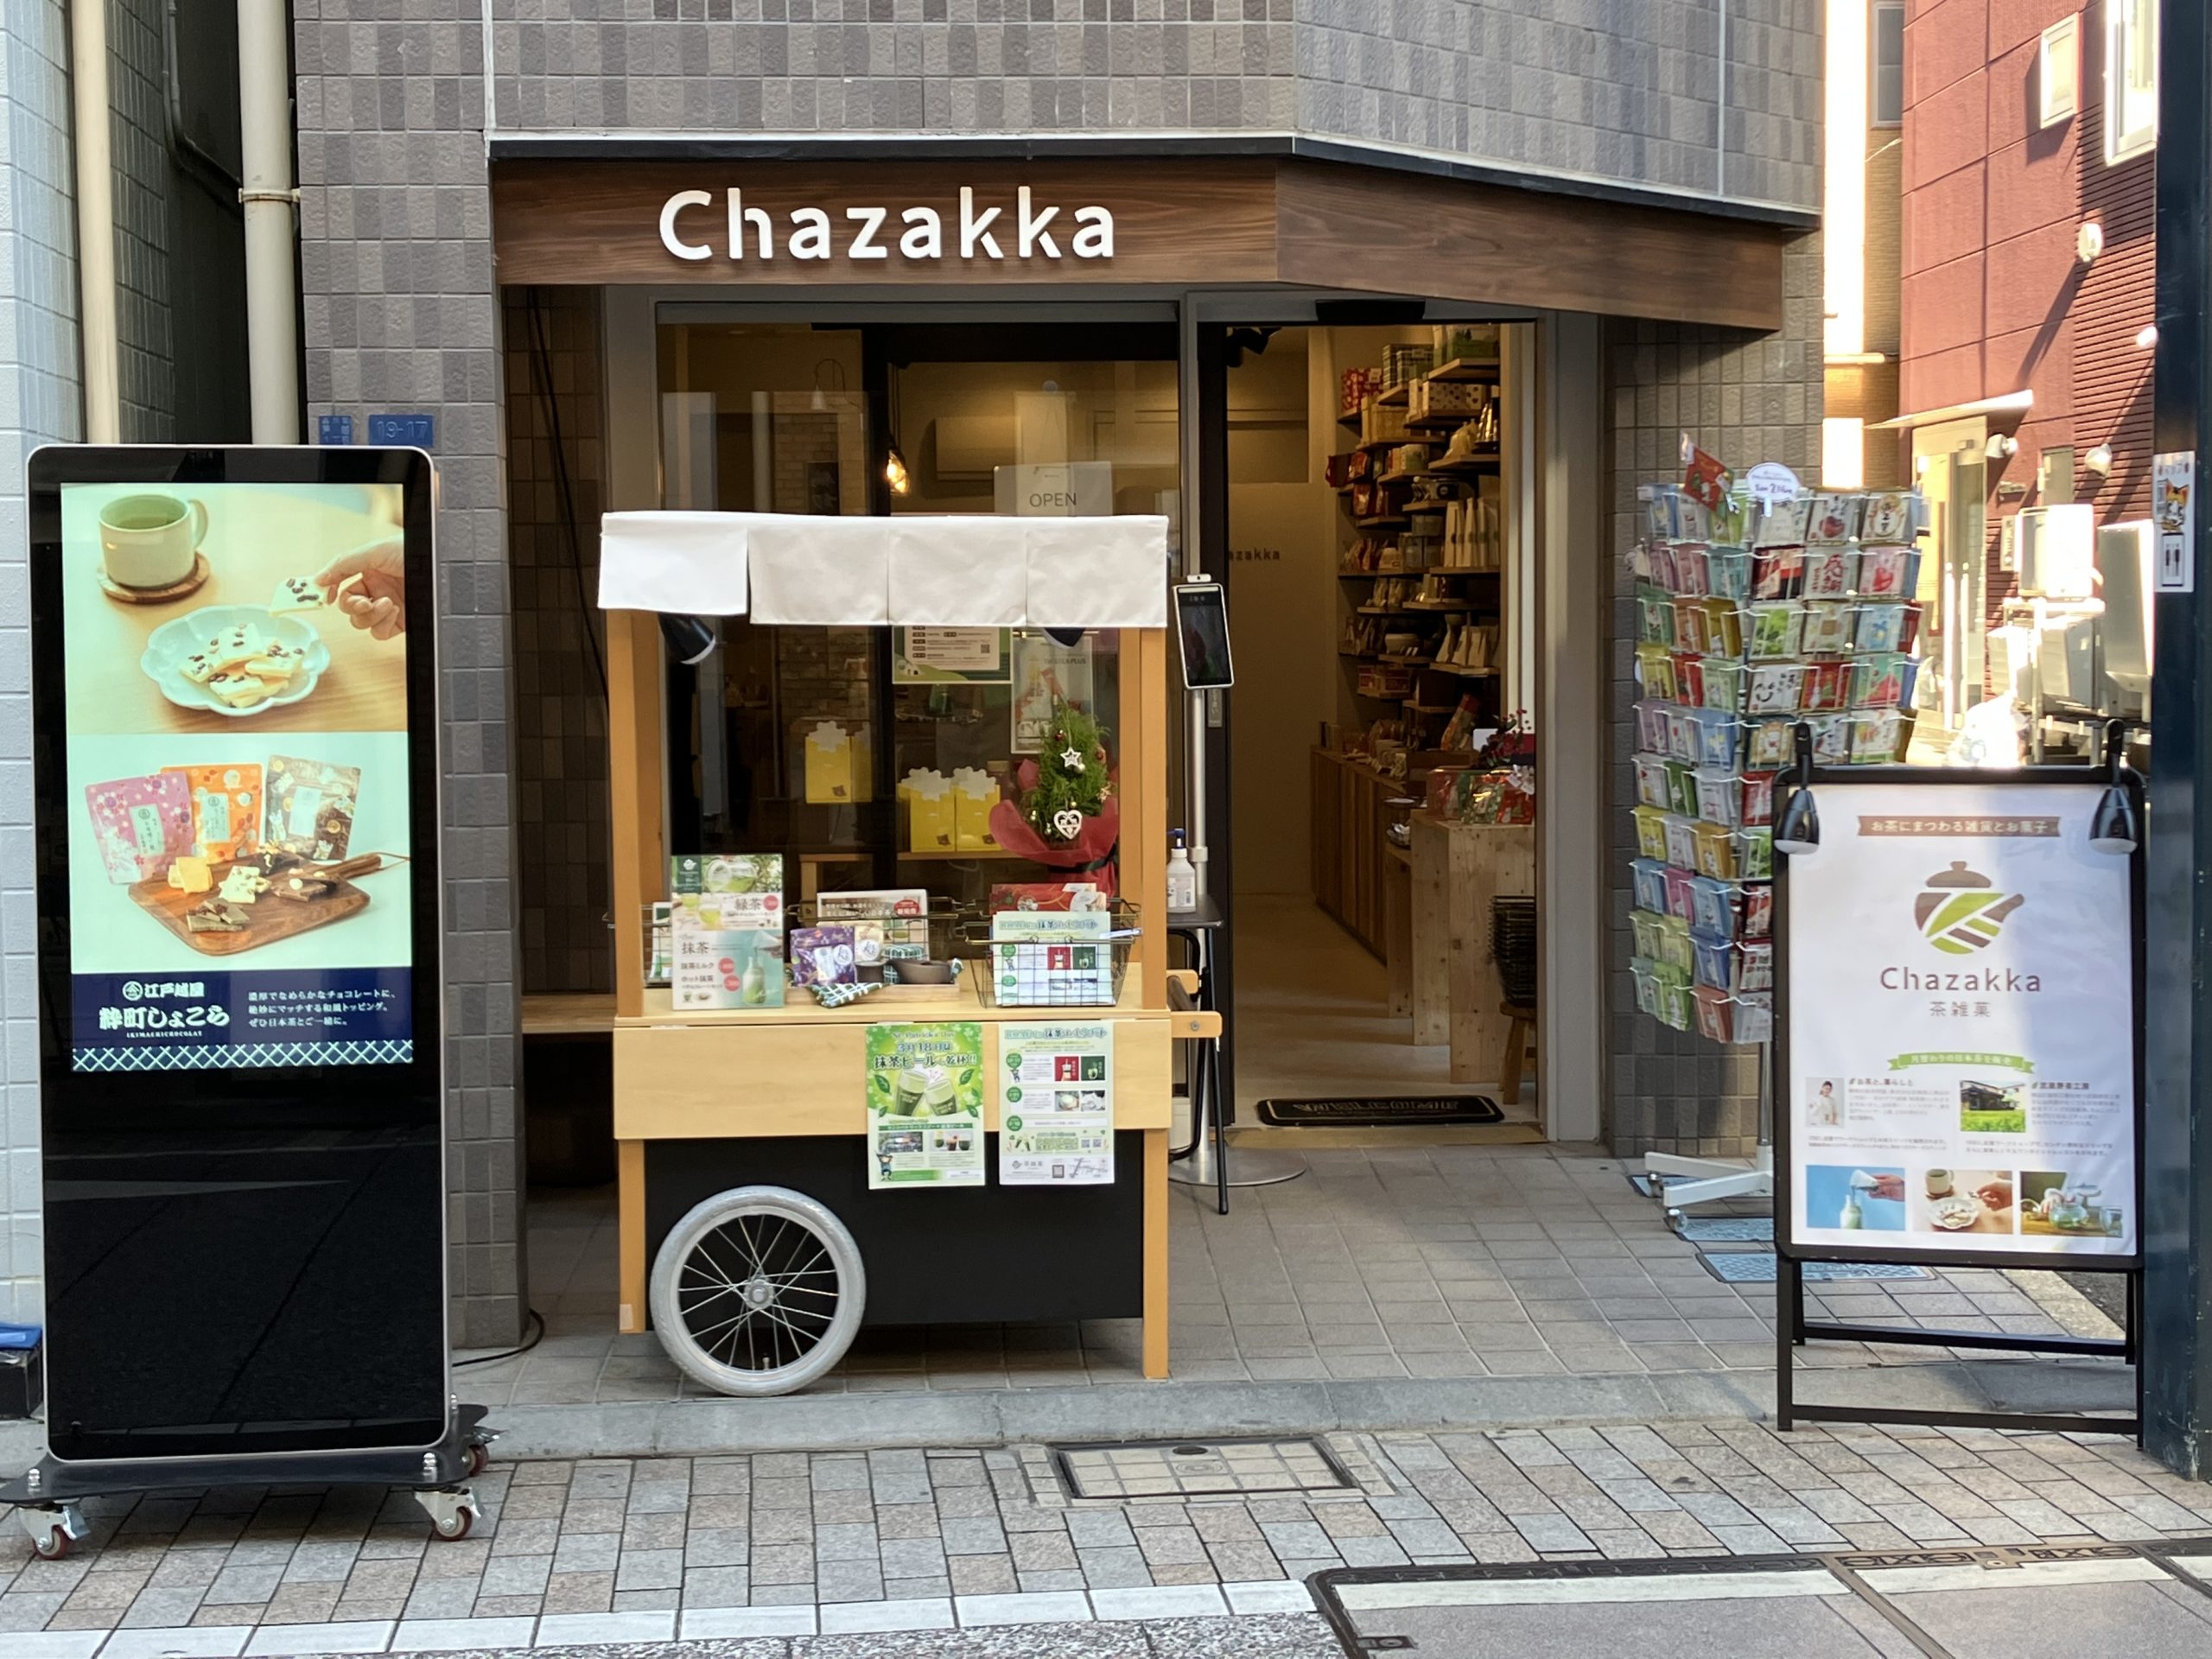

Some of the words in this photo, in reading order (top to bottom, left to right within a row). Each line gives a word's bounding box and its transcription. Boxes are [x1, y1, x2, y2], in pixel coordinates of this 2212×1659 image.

[659, 185, 1115, 260] Chazakka
[377, 421, 429, 439] 19-17
[1029, 493, 1077, 507] OPEN
[1871, 819, 2048, 833] お茶にまつわる雑貨とお菓子
[734, 898, 762, 911] 緑茶
[681, 941, 710, 955] 抹茶
[1880, 966, 2041, 992] Chazakka
[1929, 1001, 1991, 1017] 茶雑菓
[248, 1016, 348, 1027] ぜひ日本茶とご一緒に。
